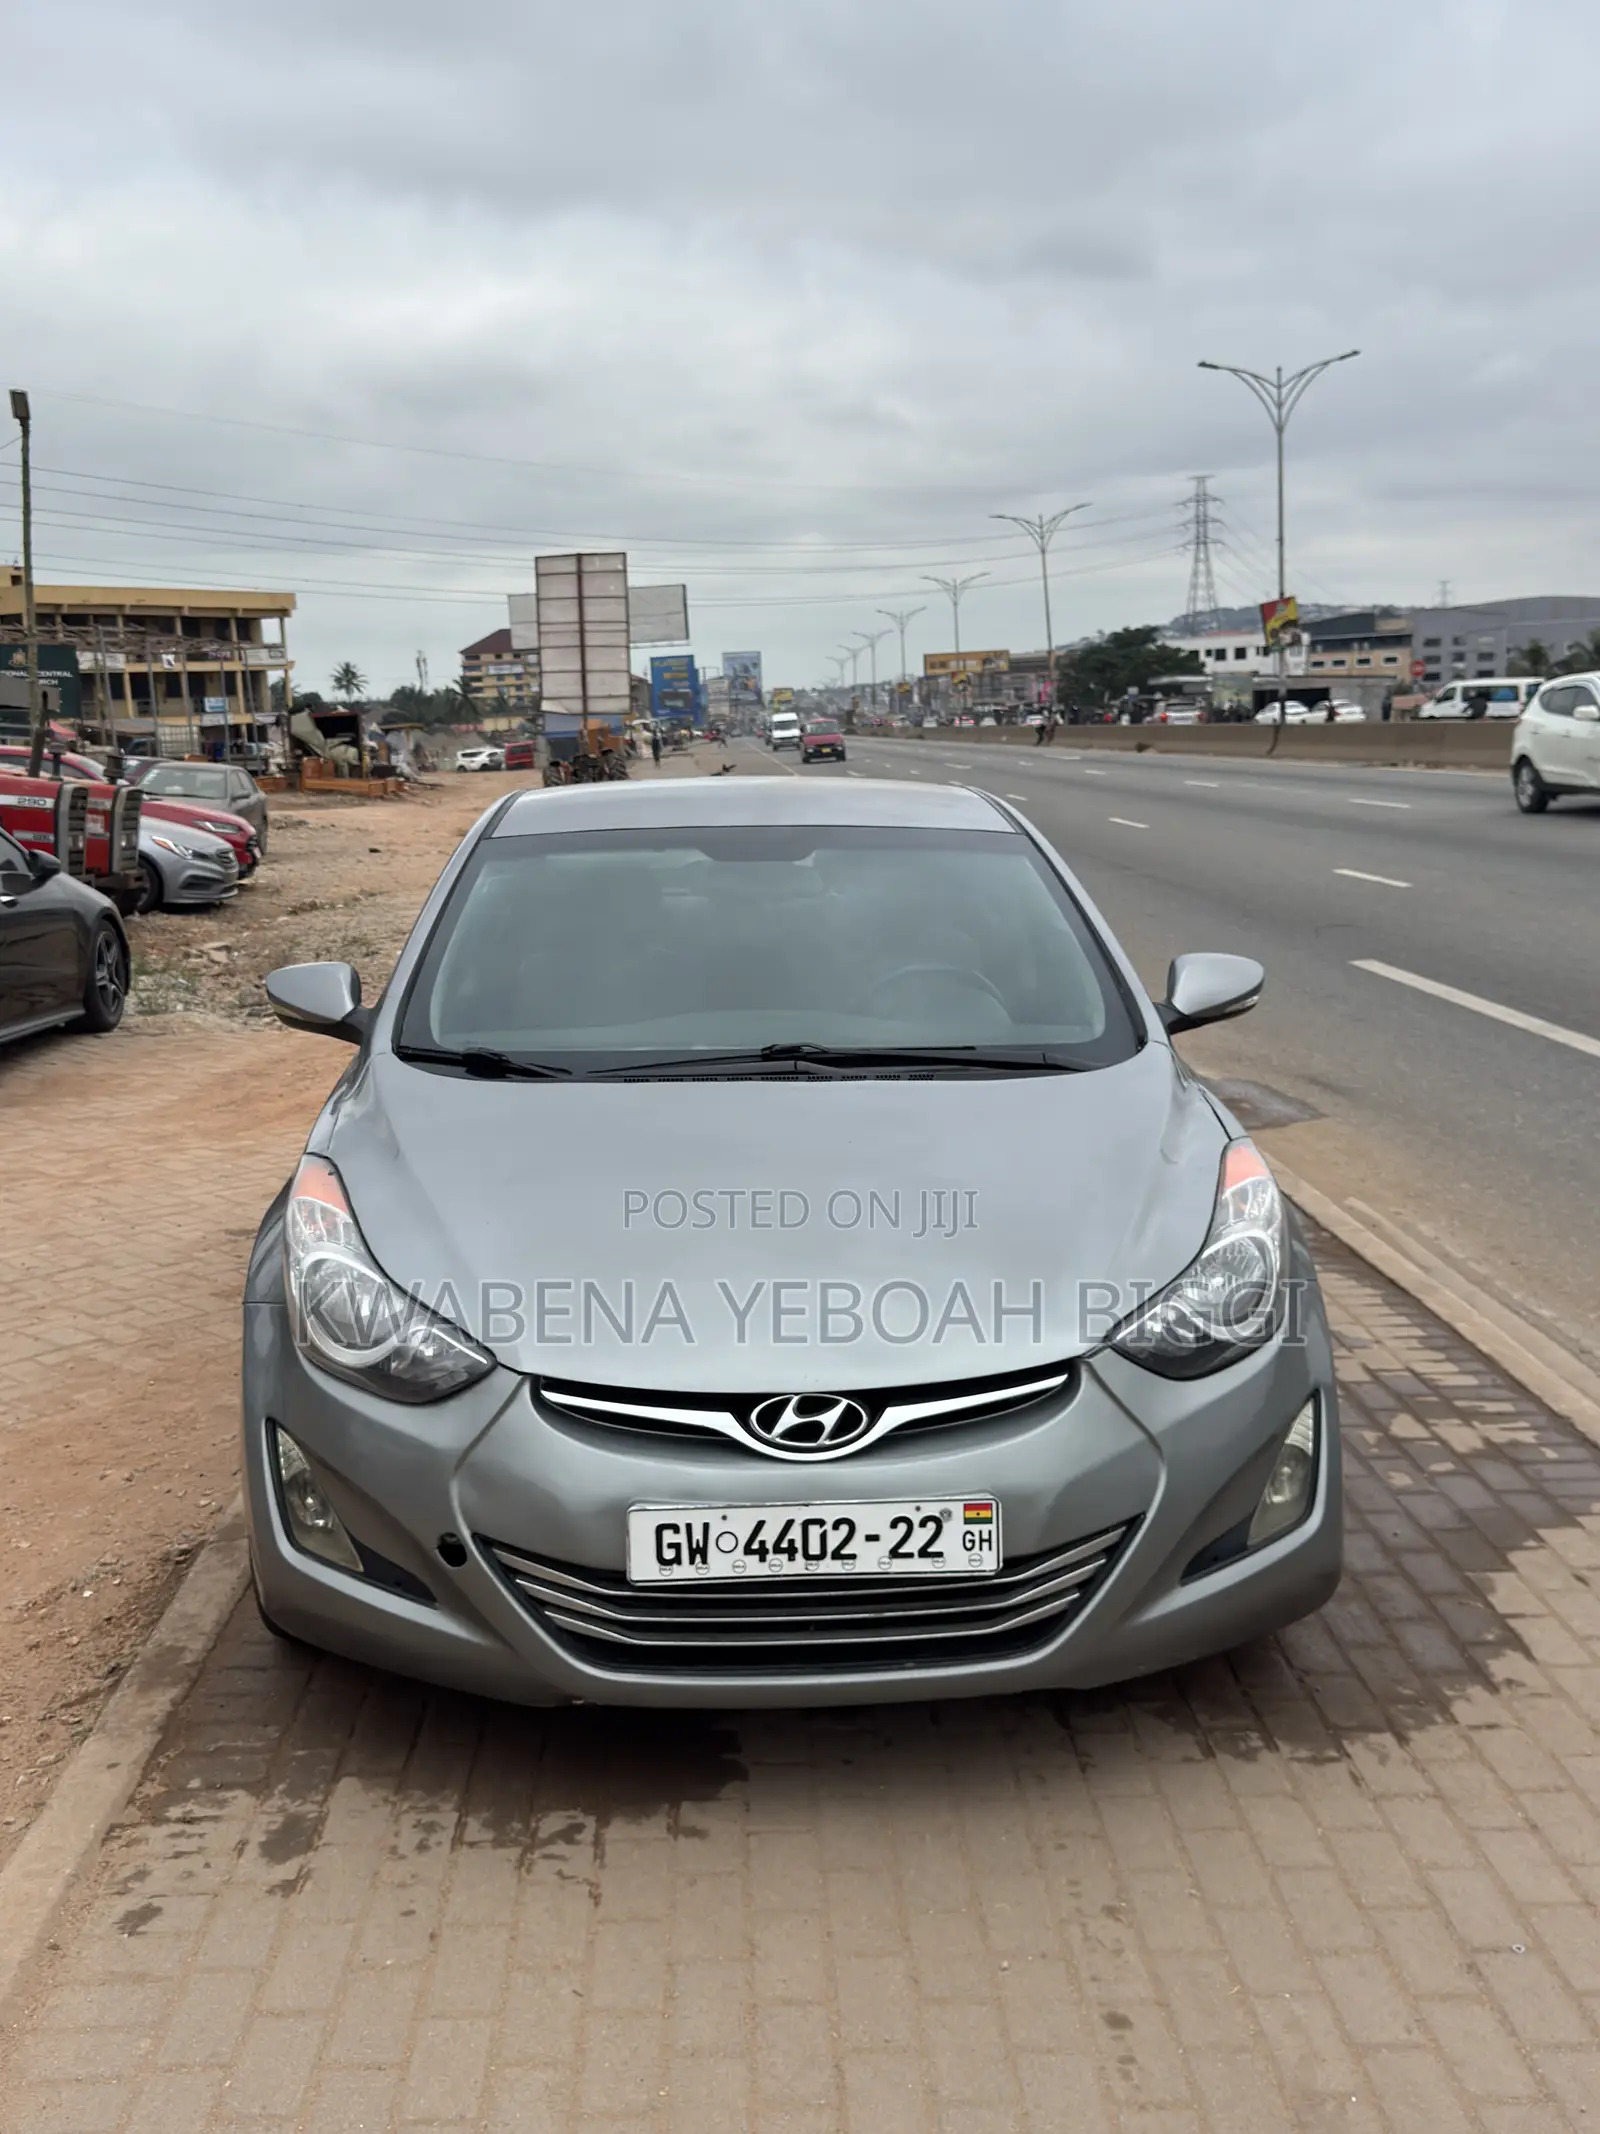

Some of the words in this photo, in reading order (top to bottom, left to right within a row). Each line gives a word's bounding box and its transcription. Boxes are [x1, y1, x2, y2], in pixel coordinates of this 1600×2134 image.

[655, 1521, 711, 1567] GW
[743, 1515, 945, 1562] 4402-22
[962, 1529, 993, 1552] GH
